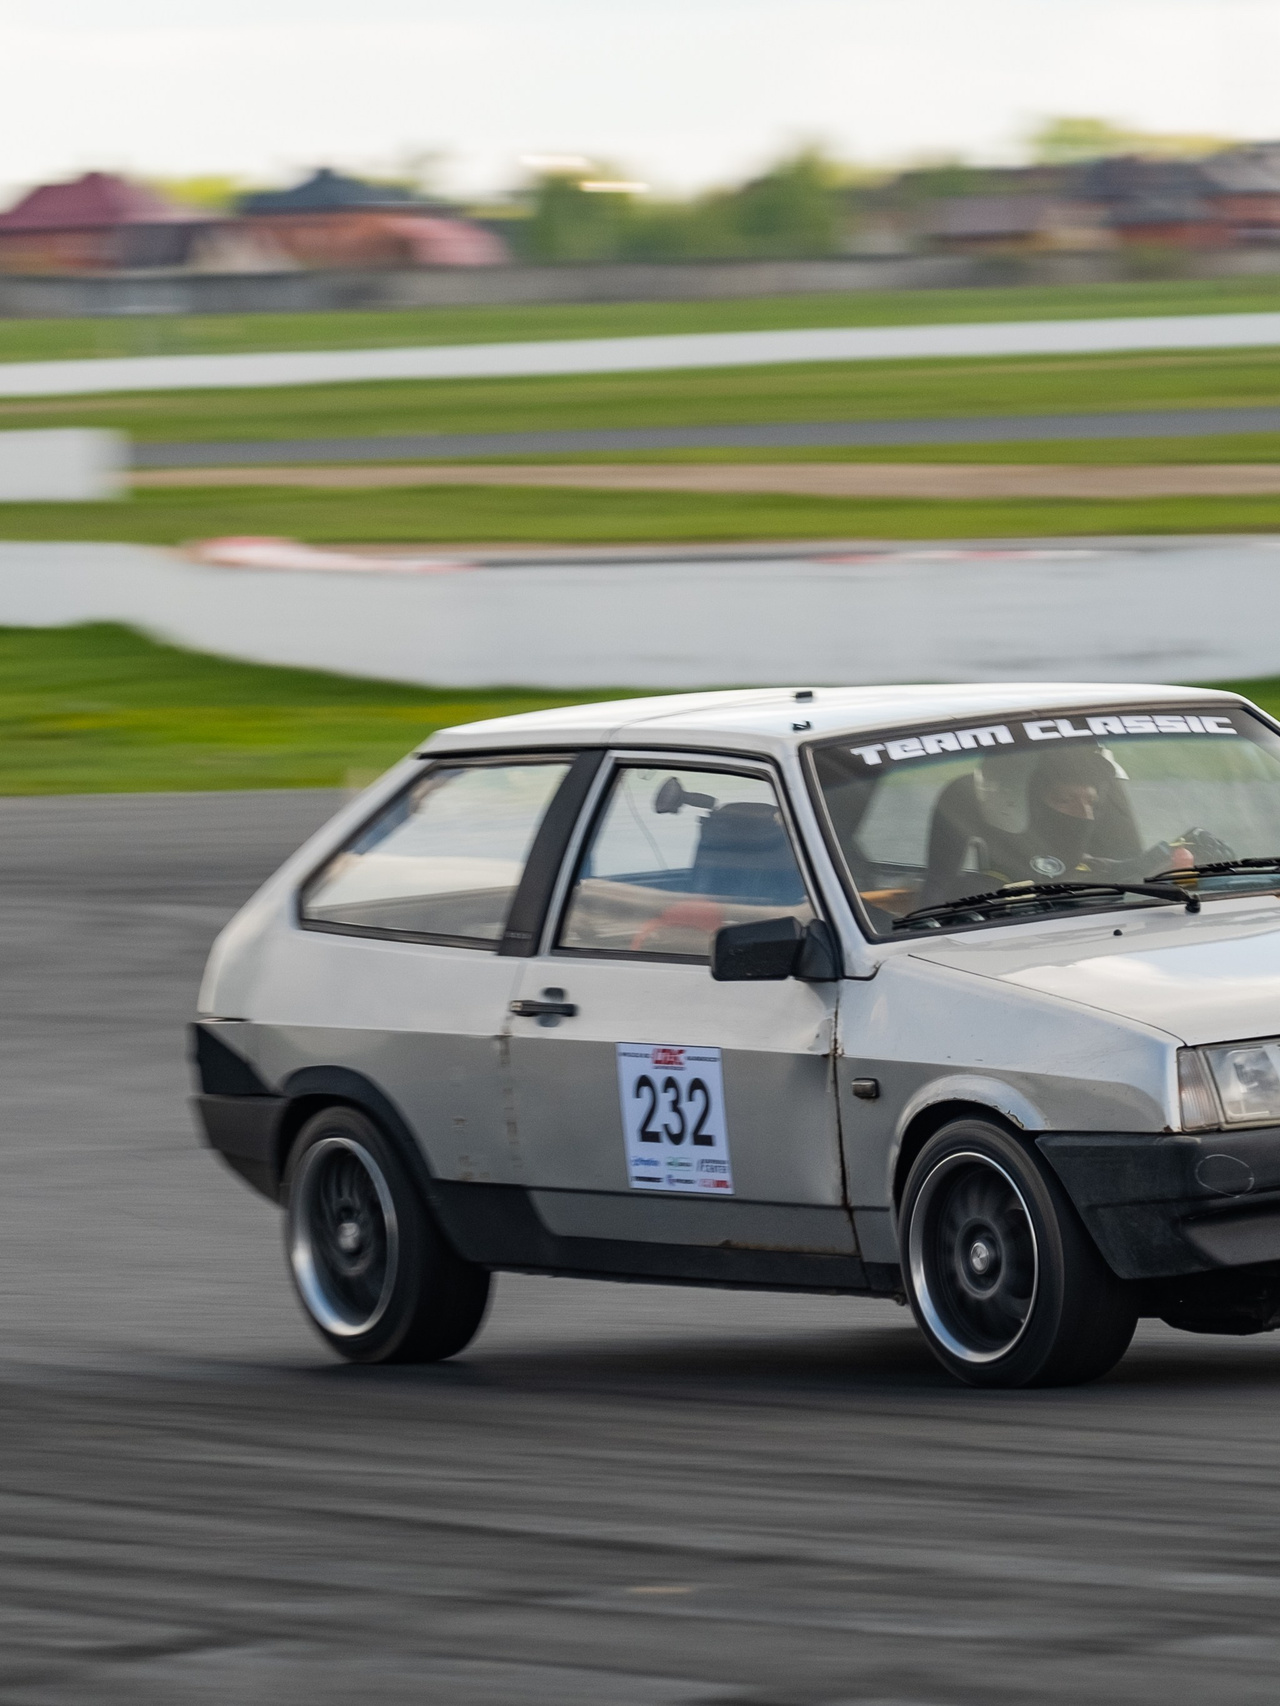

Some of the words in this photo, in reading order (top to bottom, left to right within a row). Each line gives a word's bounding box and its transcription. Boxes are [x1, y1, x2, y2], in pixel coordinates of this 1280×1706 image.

[850, 724, 1014, 766] TEAM
[1022, 715, 1238, 742] CLASSIC
[633, 1074, 716, 1147] 232
